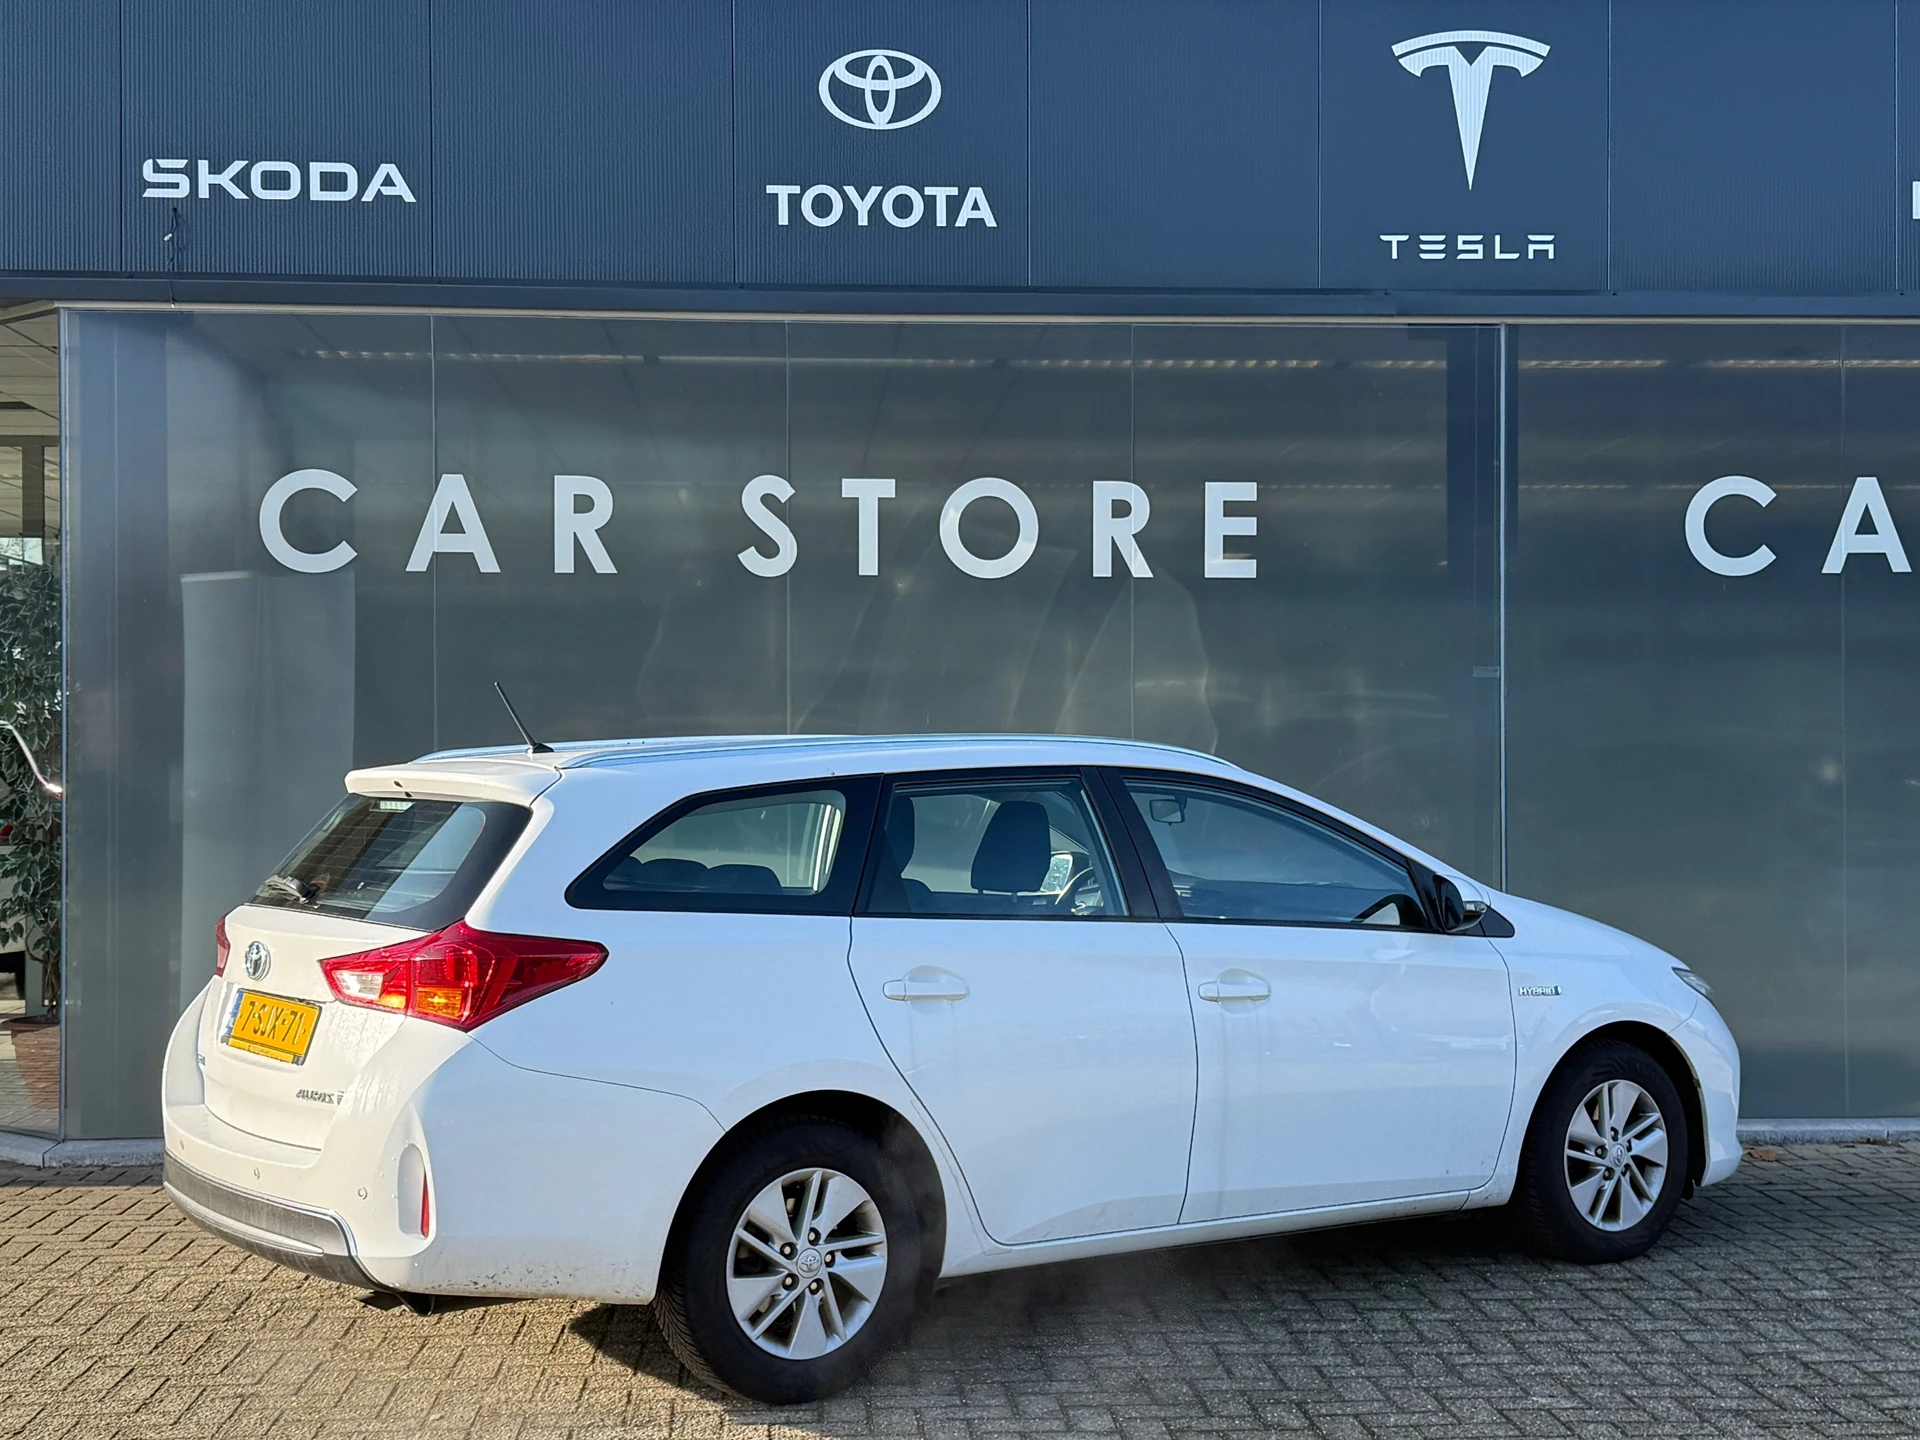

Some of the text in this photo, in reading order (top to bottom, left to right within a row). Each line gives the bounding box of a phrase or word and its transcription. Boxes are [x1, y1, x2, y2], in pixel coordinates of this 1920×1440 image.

[765, 184, 998, 228] TOYOTA
[1379, 234, 1555, 260] TESLA
[259, 468, 1258, 579] CAR STORE
[1685, 475, 1912, 577] CA
[1519, 986, 1555, 996] HYBRID
[241, 1000, 305, 1045] 7-SJX-71
